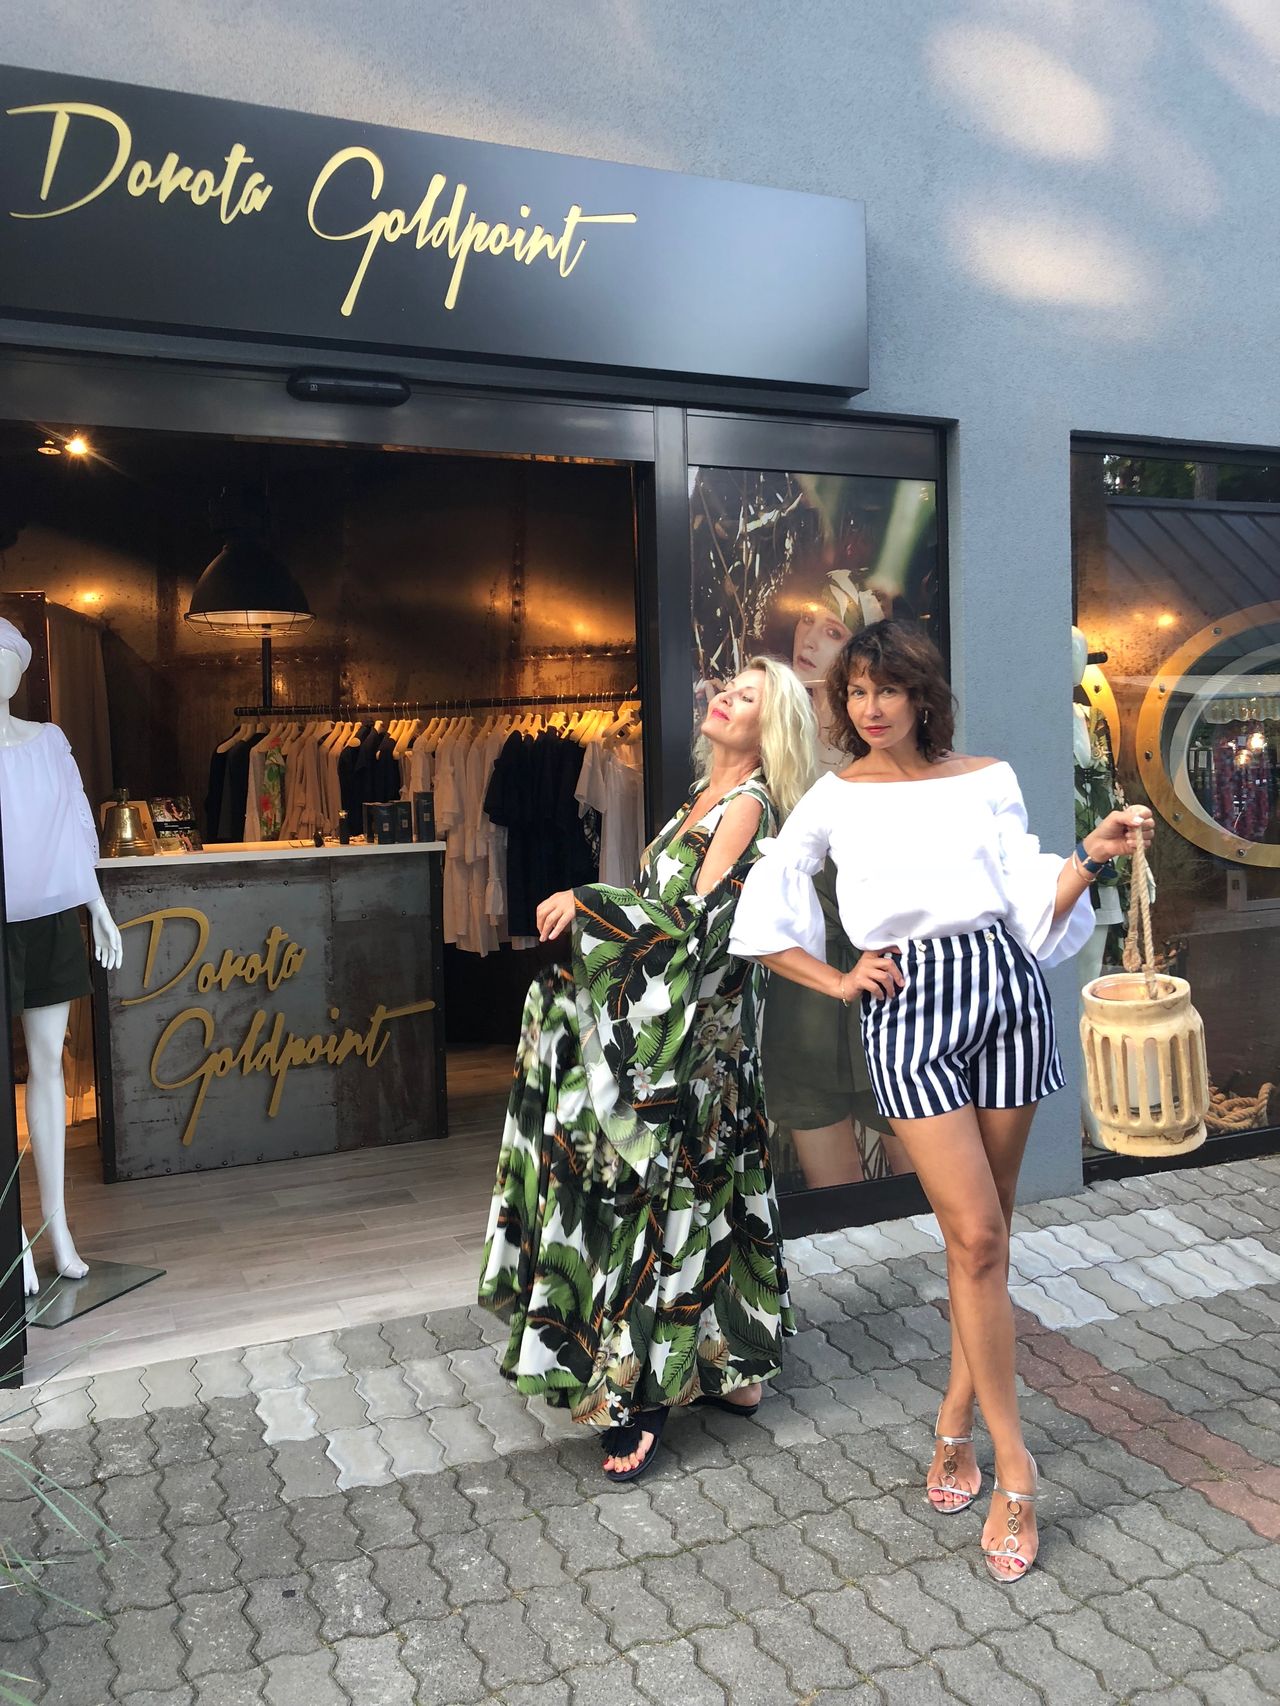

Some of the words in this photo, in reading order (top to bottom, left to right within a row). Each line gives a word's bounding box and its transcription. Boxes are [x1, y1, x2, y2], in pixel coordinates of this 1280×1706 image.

[6, 102, 272, 224] Dorota
[307, 147, 637, 317] Goldpoint
[118, 907, 306, 1006] Dorota
[151, 1000, 436, 1145] Goldpoint
